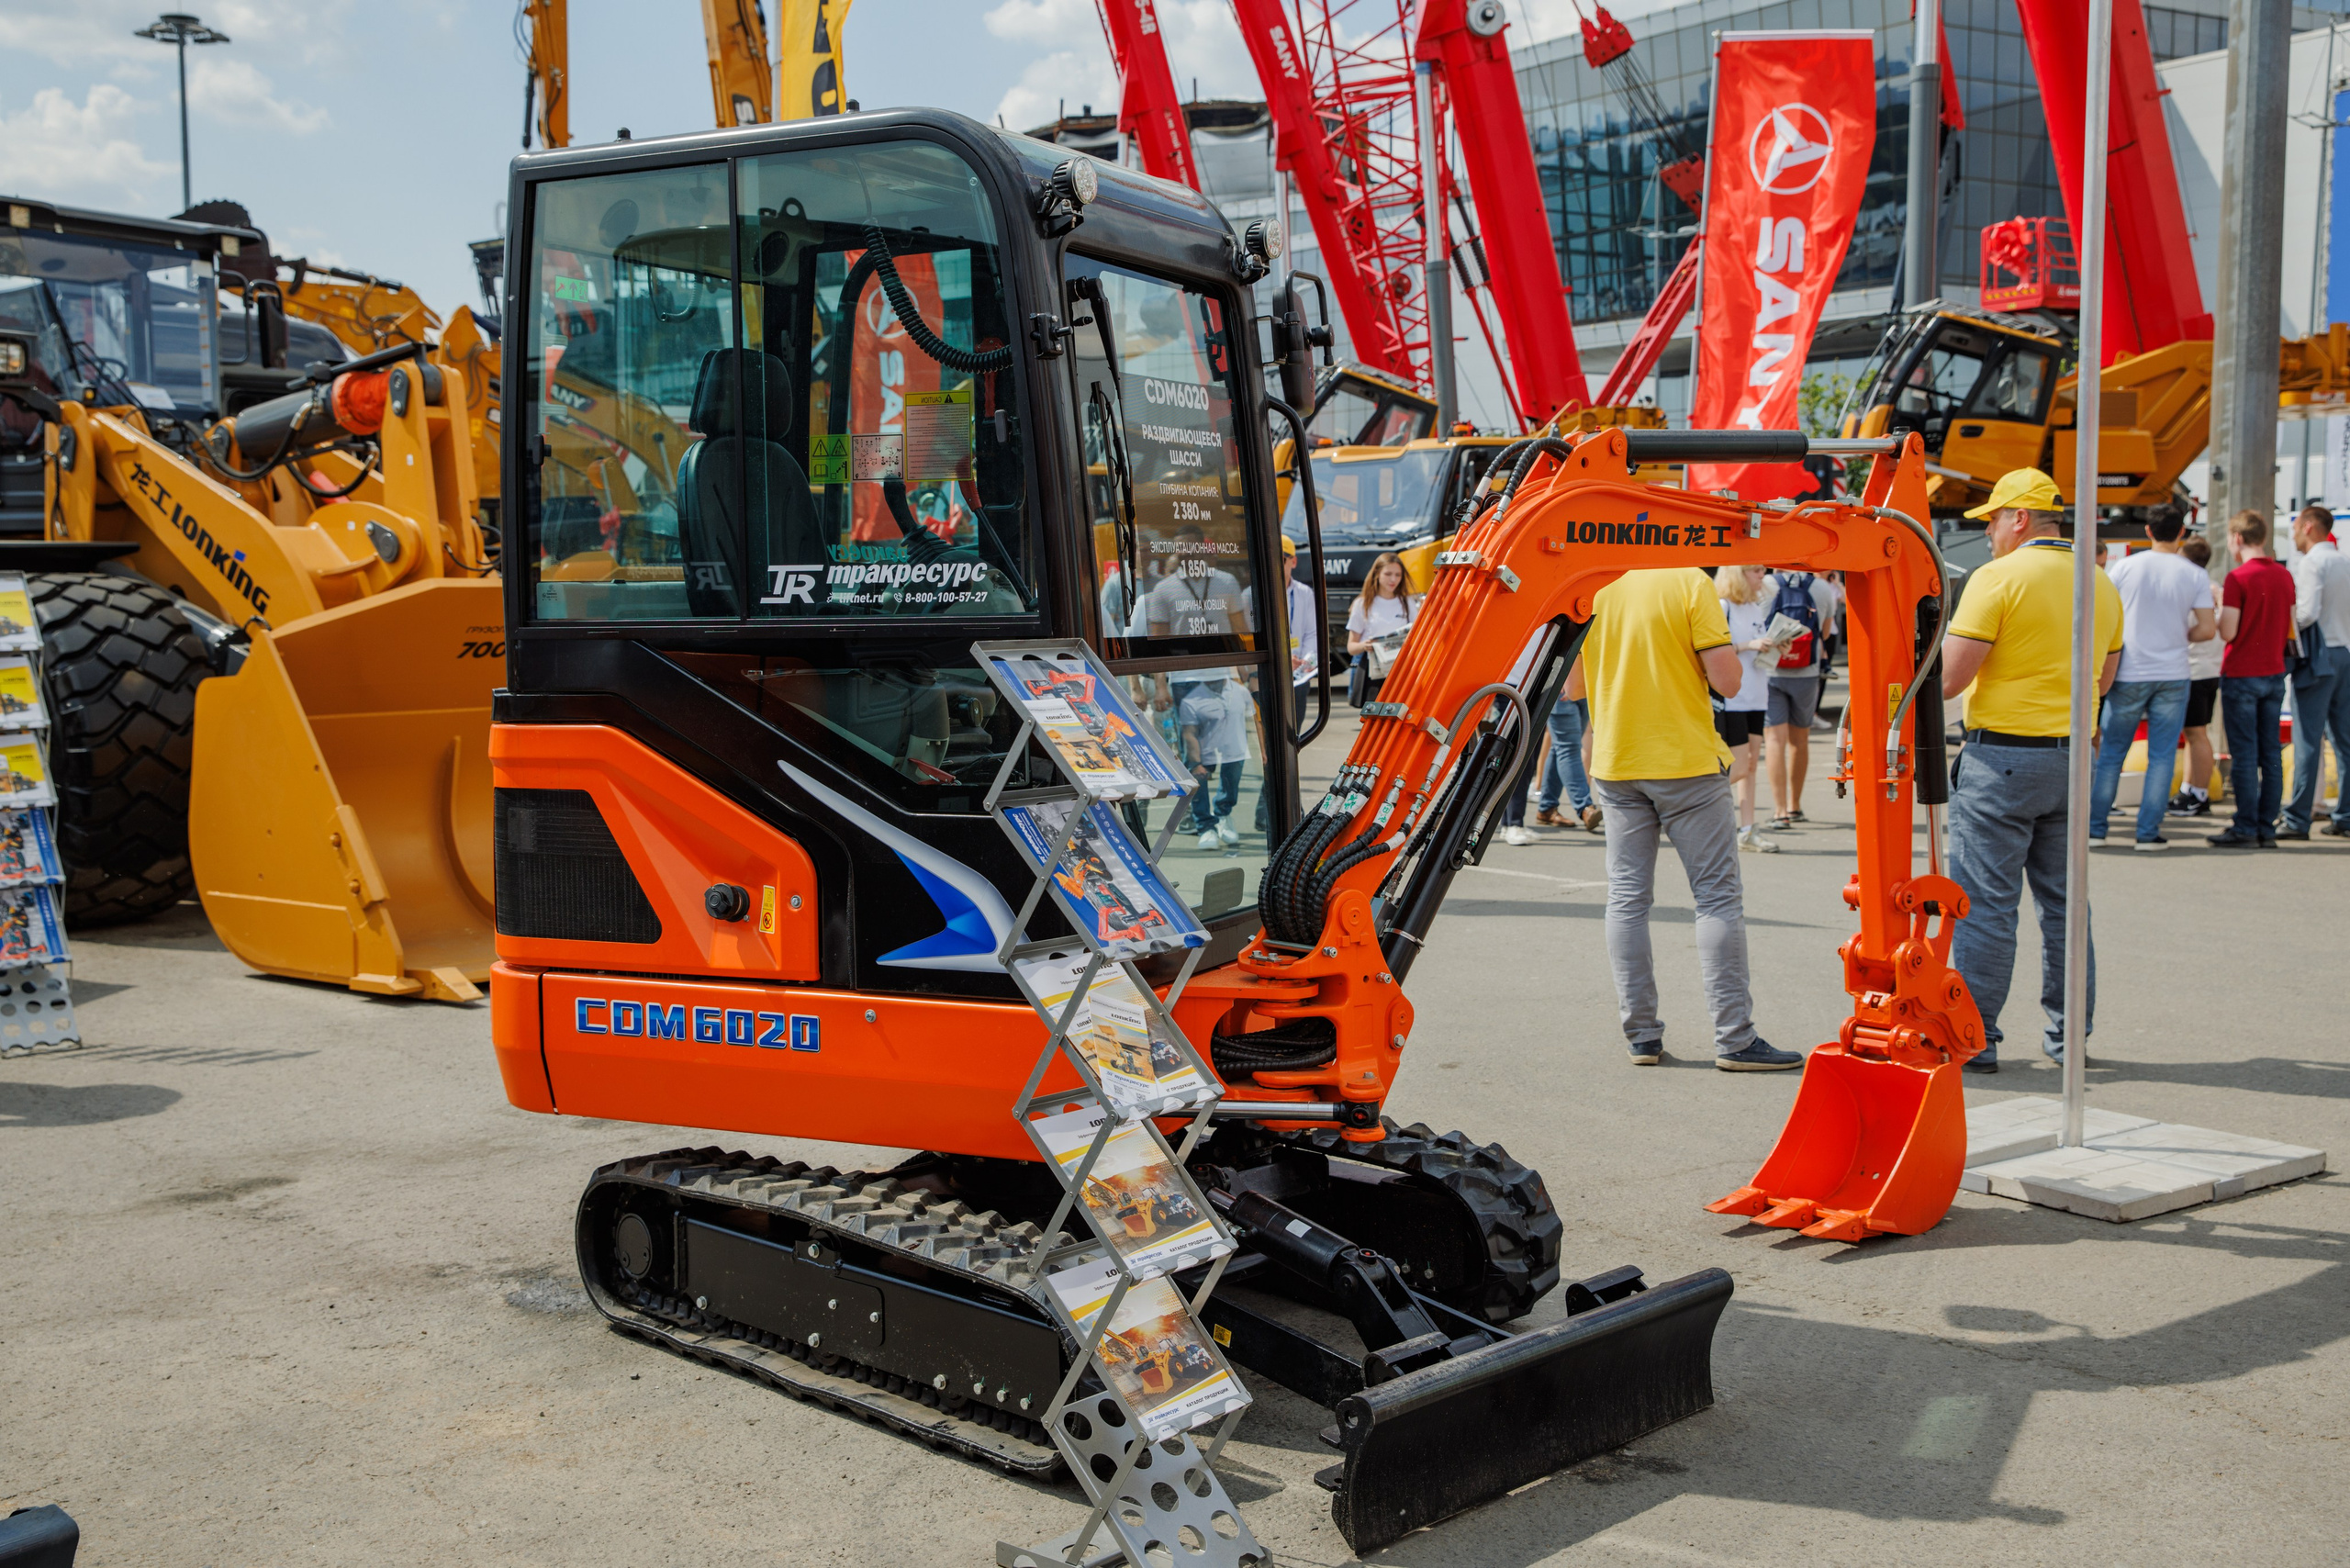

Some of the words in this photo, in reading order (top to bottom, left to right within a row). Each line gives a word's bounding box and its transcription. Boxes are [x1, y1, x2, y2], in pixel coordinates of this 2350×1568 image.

[1270, 25, 1300, 81] SANY
[1736, 216, 1807, 431] SANY
[551, 384, 589, 409] ANY
[1144, 378, 1210, 411] CDM6020
[1141, 423, 1223, 448] РАЗДВИГАЮЩЕЕСЯ
[1169, 449, 1203, 467] ШАССИ
[1159, 483, 1188, 496] ГЛУБИНА
[1188, 485, 1219, 498] КОПАНИЯ:
[1566, 510, 1680, 546] LONKING
[171, 502, 271, 616] LONKING
[1149, 541, 1216, 555] ЭКСПЛУАТАЦИОННАЯ
[1216, 543, 1240, 554] МАССА:
[826, 562, 989, 589] тракресурс
[904, 590, 989, 604] 8-800-100-57-27
[1175, 599, 1203, 611] ШИРИНА
[1203, 599, 1227, 610] КОВША:
[1188, 616, 1207, 635] 380
[1169, 1242, 1188, 1252] КАТАЛОГ
[1188, 1235, 1214, 1248] ПРОДУКЦИИ
[1185, 1395, 1204, 1408] КАТАЛОГ
[1204, 1387, 1229, 1402] ПРОДУКЦИИ
